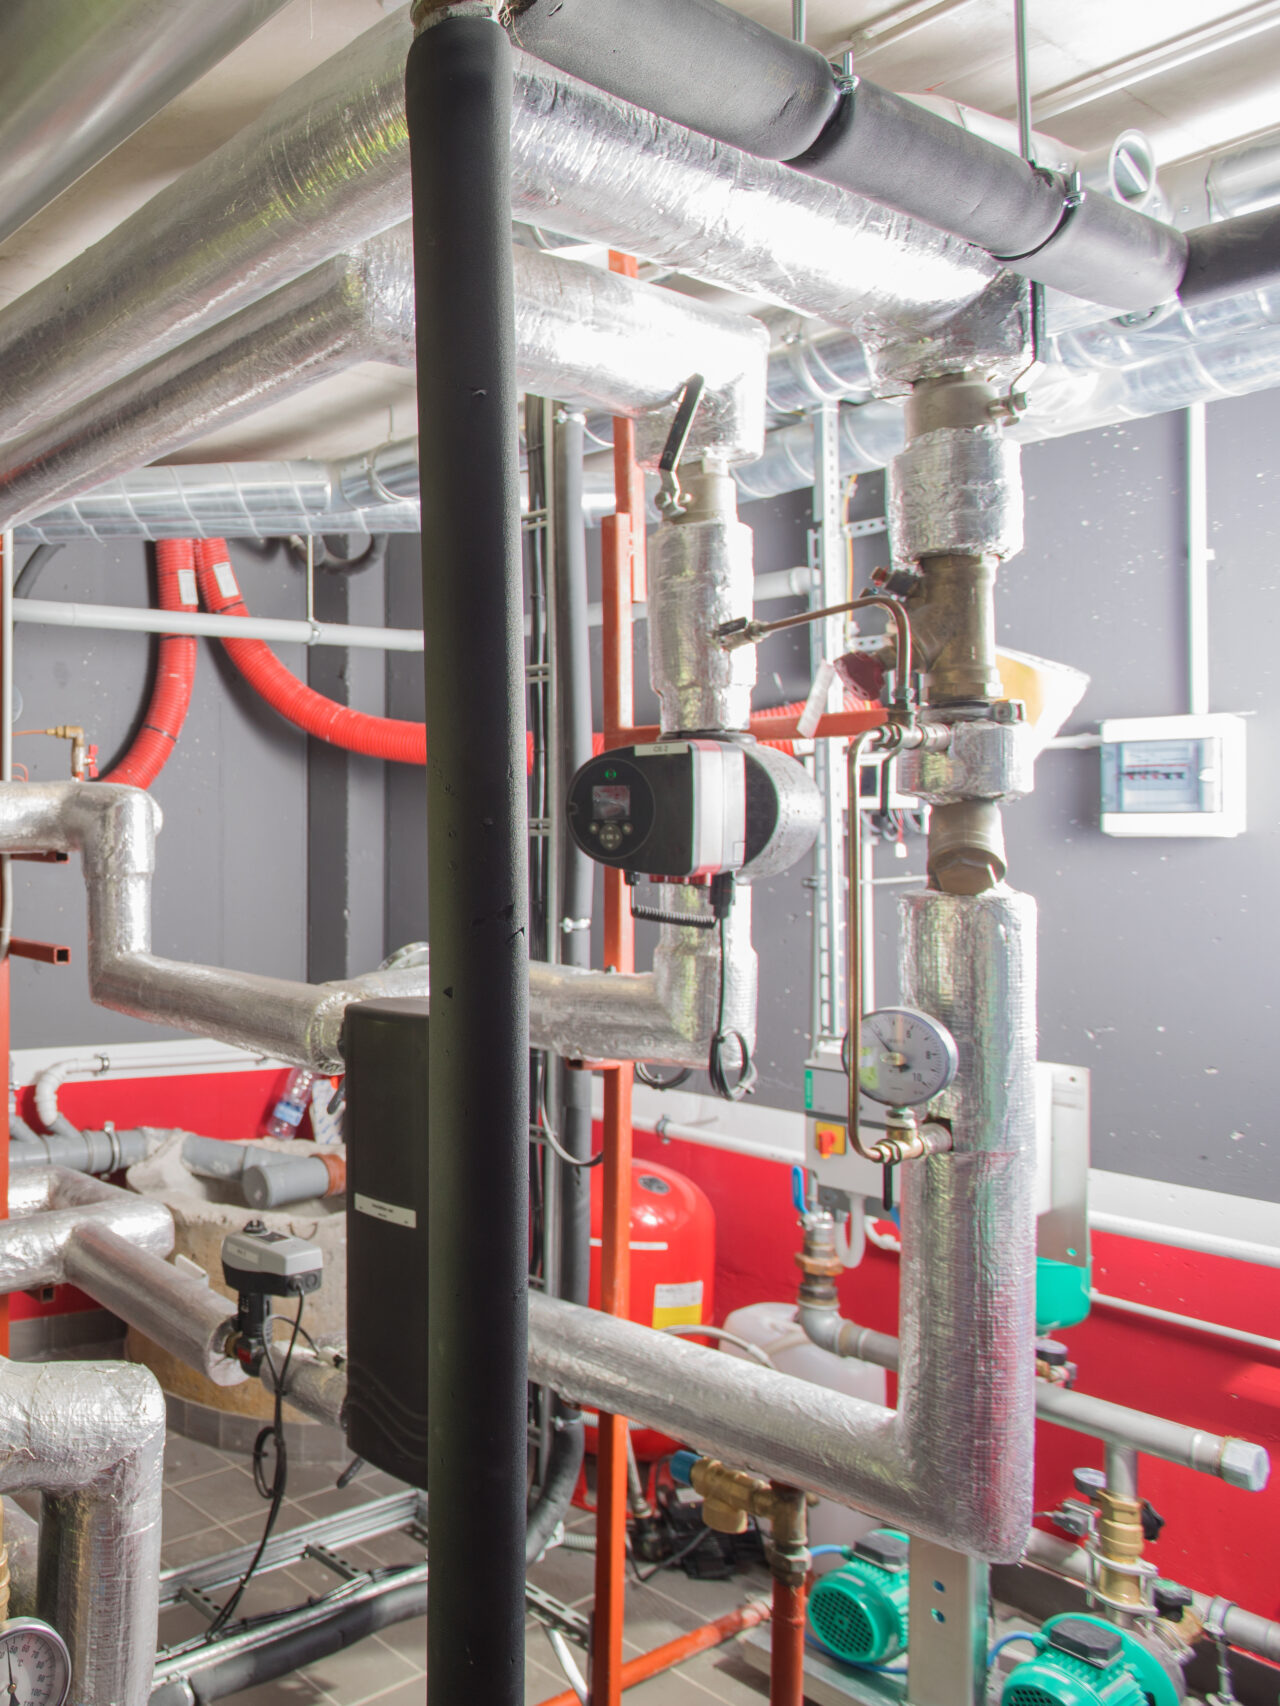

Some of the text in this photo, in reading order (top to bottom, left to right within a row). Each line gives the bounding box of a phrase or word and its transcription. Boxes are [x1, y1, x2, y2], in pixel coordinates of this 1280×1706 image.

[913, 1072, 922, 1081] 10
[9, 1646, 18, 1654] 50
[31, 1688, 42, 1697] 100
